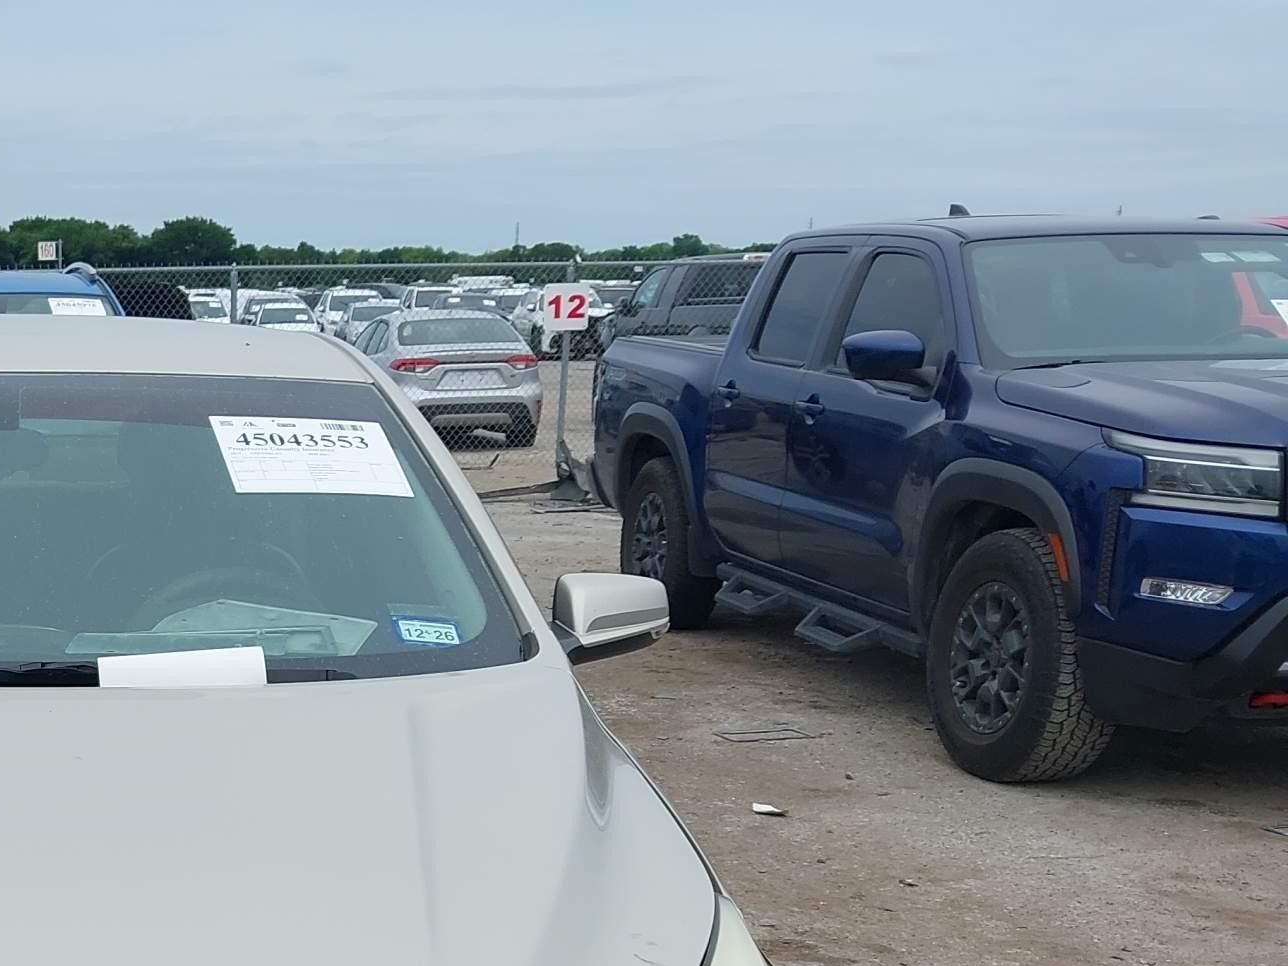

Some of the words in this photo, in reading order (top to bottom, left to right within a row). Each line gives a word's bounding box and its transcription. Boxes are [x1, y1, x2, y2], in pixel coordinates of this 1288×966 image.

[40, 243, 55, 257] 160
[548, 294, 586, 319] 12
[236, 432, 369, 450] 45043553
